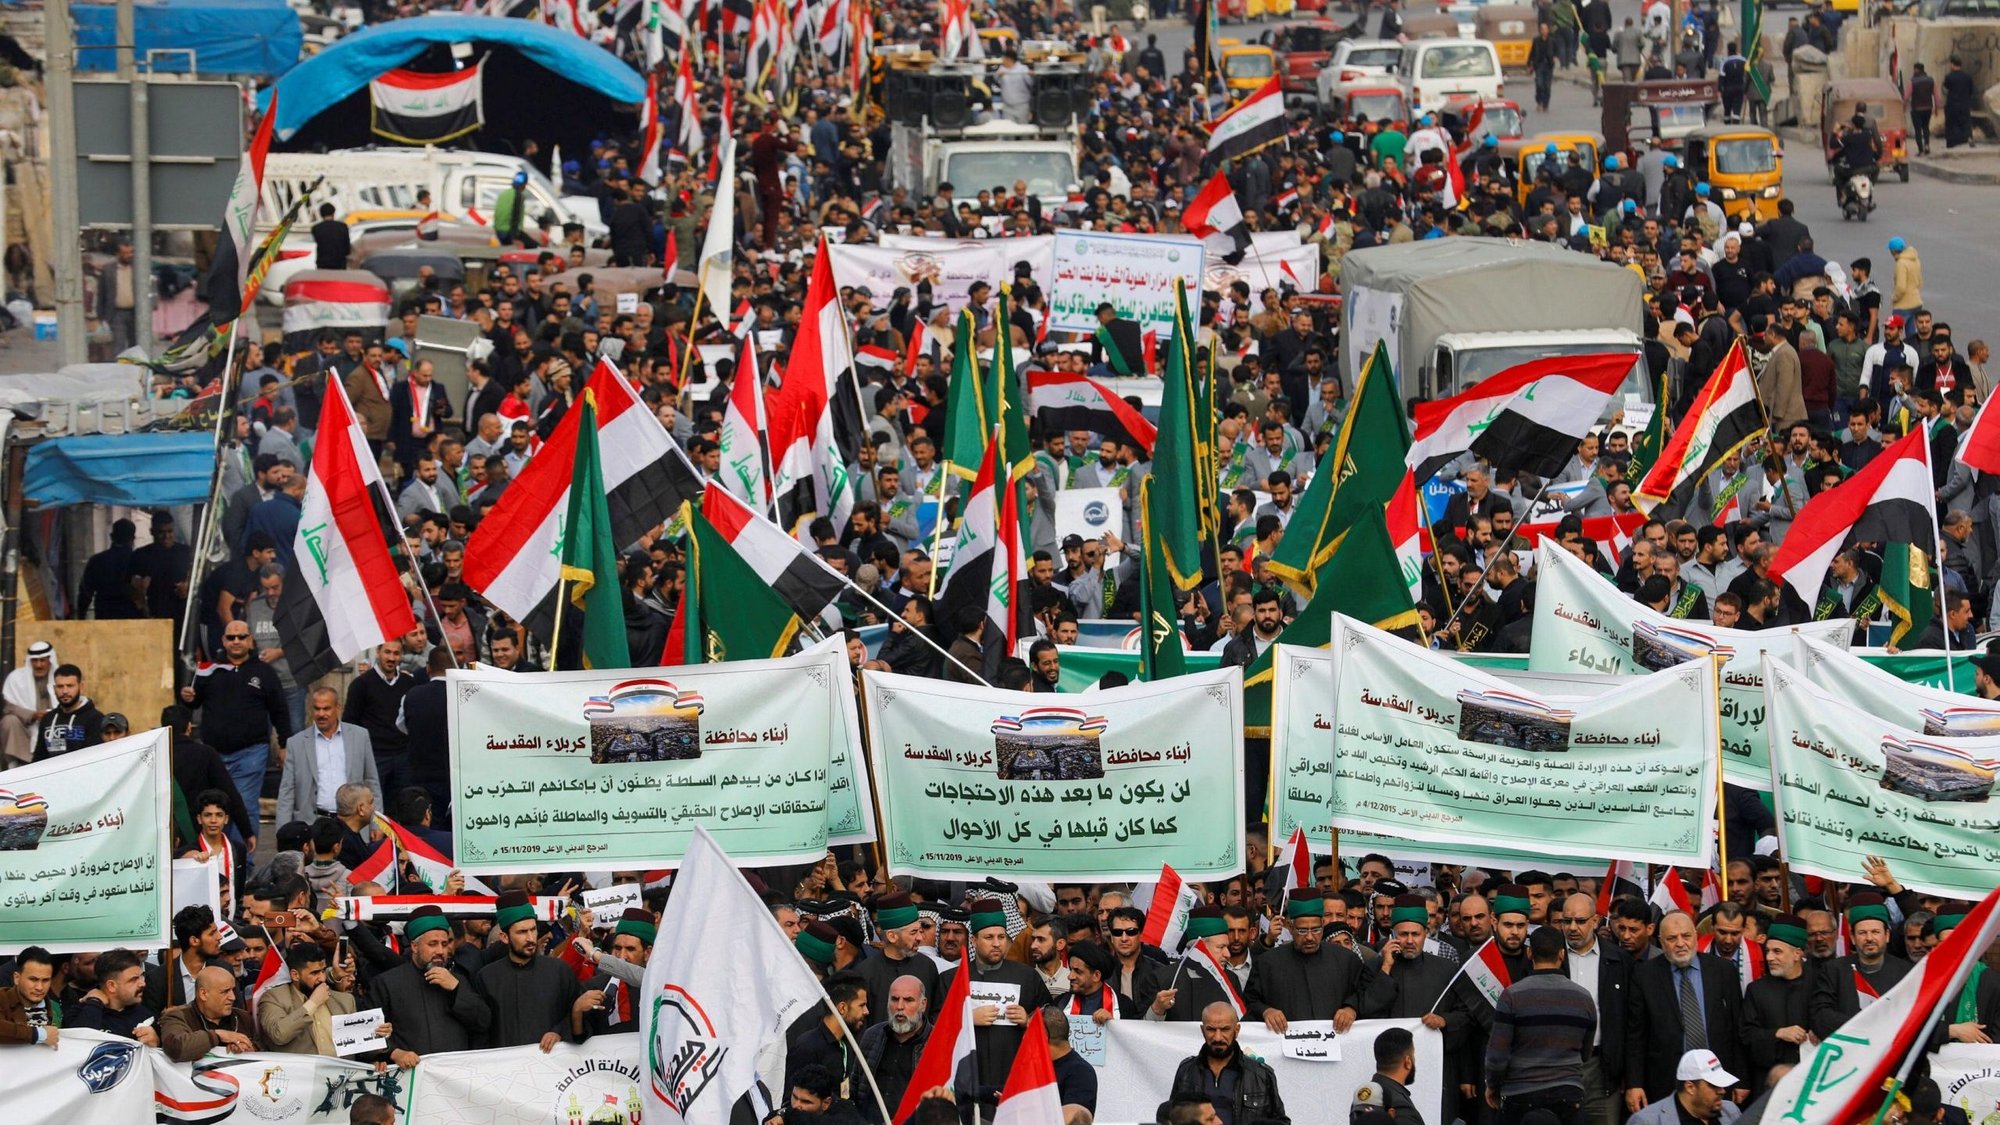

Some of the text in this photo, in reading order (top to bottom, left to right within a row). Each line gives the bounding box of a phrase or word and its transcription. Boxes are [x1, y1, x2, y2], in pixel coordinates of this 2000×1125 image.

[1553, 602, 1601, 632] المقدسة
[1360, 688, 1661, 746] أبناء محافظة كربلاء المقدسة
[485, 722, 789, 752] أبناء محافظة كربلاء المقدسة
[1360, 729, 1392, 746] الأساس
[1393, 734, 1424, 750] العامل
[903, 741, 1191, 768] أبناء محافظة كربلاء المقدسة
[1336, 747, 1349, 759] من
[1351, 749, 1368, 762] البلد
[1425, 741, 1460, 756] ستكون
[1462, 747, 1497, 763] الراسخة
[1792, 730, 1880, 773] كربلاء المقدسة
[1369, 753, 1407, 770] وتخليص
[1409, 758, 1439, 775] الرشيد
[1499, 753, 1541, 770] والعزيمة
[1543, 757, 1575, 770] الصلبة
[1610, 762, 1632, 773] هذه
[1441, 766, 1467, 781] الحكم
[1685, 766, 1700, 776] من
[665, 772, 717, 788] السلطة
[720, 775, 761, 790] بيدهم
[764, 772, 782, 787] من
[1539, 776, 1570, 789] معركة
[1571, 780, 1587, 794] في
[464, 783, 483, 800] من
[925, 779, 1191, 807] لن يكون ما بعد هذه الاحتجاجات
[1626, 783, 1659, 794] الشعب
[1660, 785, 1697, 799] وانتصار
[1493, 790, 1528, 806] العراق
[1529, 796, 1562, 810] جعلوا
[1565, 798, 1596, 812] الذين
[1824, 787, 1870, 808] لحسم
[720, 803, 765, 822] الإصلاح
[768, 799, 827, 815] استحقاقات
[1362, 801, 1397, 813] 4/12/2015
[1598, 799, 1650, 814] الفاسدين
[1653, 801, 1695, 817] مجاميع
[46, 807, 125, 837] أبناء محافظة
[465, 813, 511, 830] واهمون
[552, 808, 608, 825] والمماطلة
[612, 806, 668, 824] بالتسويف
[1913, 808, 1956, 827] سقف
[943, 817, 1001, 841] الأحوال
[1038, 819, 1064, 848] في
[1068, 815, 1109, 844] قبلها
[1114, 817, 1145, 842] كان
[1150, 815, 1178, 836] كما
[1858, 830, 1930, 851] محاكمتهم
[500, 845, 541, 854] 15/11/2019
[926, 853, 962, 861] 15/11/2019
[1934, 842, 1979, 858] لتسريع
[30, 867, 66, 882] محيص
[70, 864, 77, 877] لا
[82, 886, 97, 905] في
[99, 883, 128, 898] ستعود
[587, 893, 638, 908] مرجعيتنا
[1284, 1030, 1336, 1042] مرجعيتنا
[1295, 1047, 1328, 1057] سندنا
